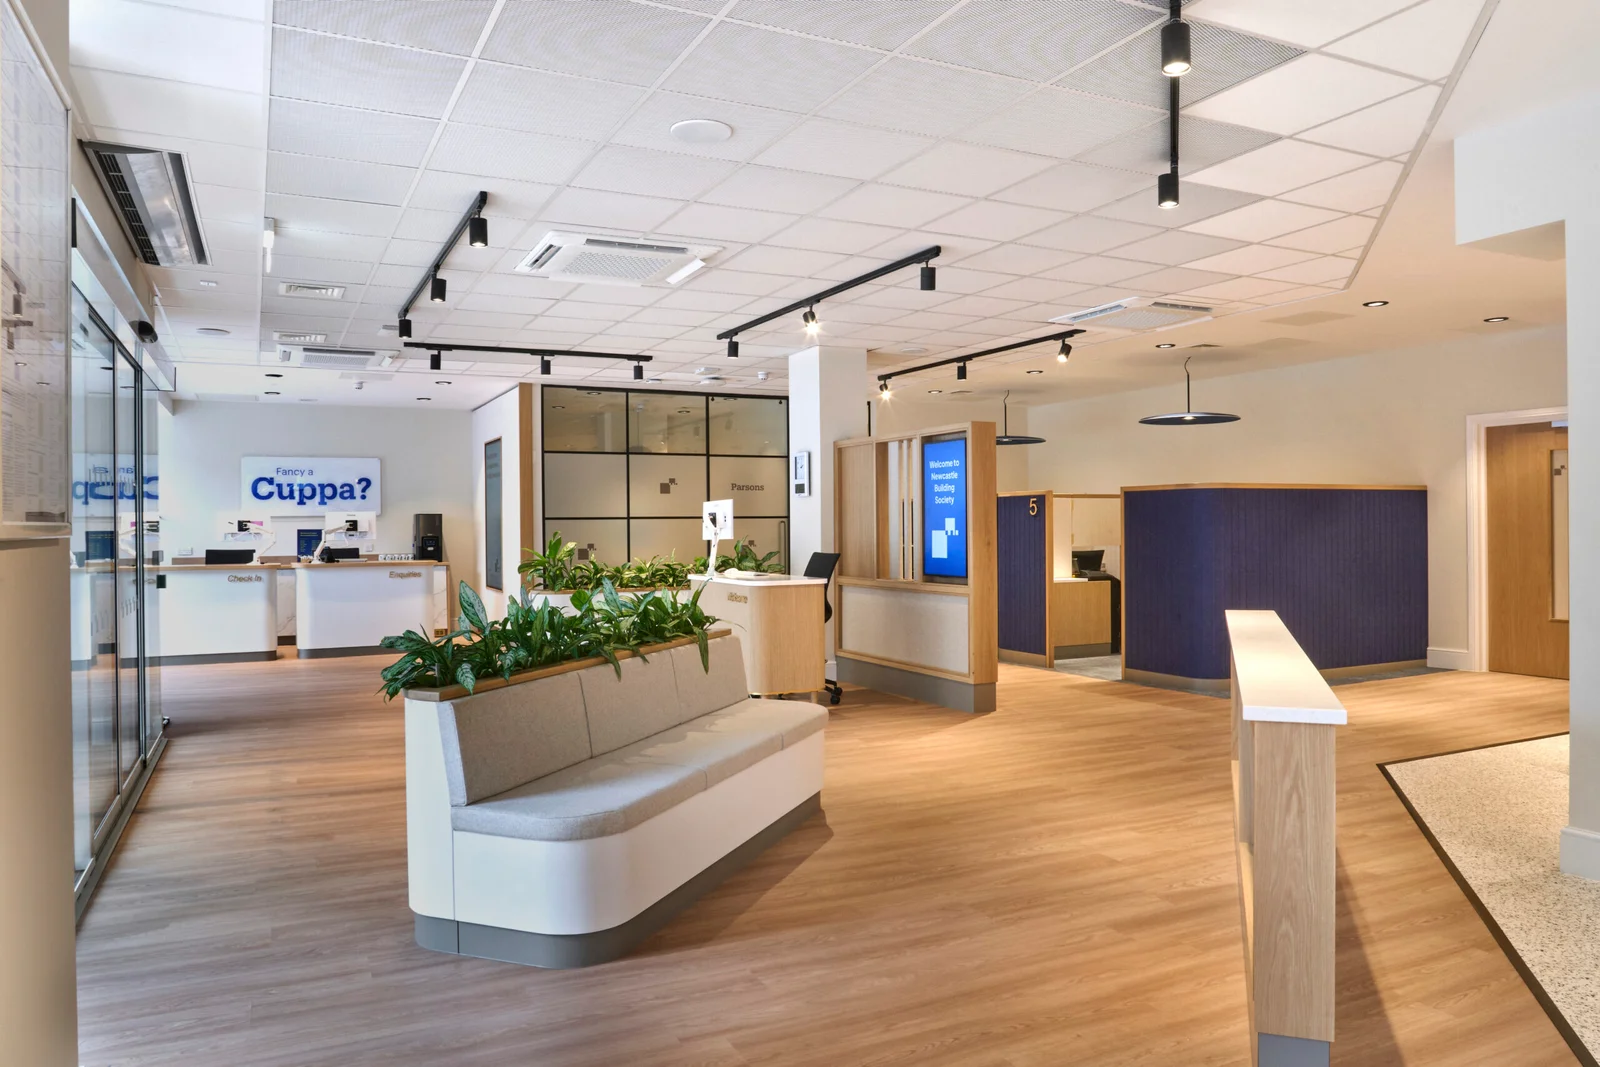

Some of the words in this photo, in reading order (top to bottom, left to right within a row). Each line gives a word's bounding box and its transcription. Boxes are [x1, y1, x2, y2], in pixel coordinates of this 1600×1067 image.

[929, 460, 953, 469] Welcome
[953, 459, 960, 467] to
[276, 467, 305, 477] Fancy
[931, 471, 958, 480] Newcastle
[251, 477, 372, 506] Cuppa?
[731, 483, 764, 491] Parsons
[934, 484, 955, 493] Building
[934, 495, 955, 505] Society
[1029, 498, 1038, 516] 5
[227, 574, 253, 583] Check
[389, 571, 422, 579] Enquiries
